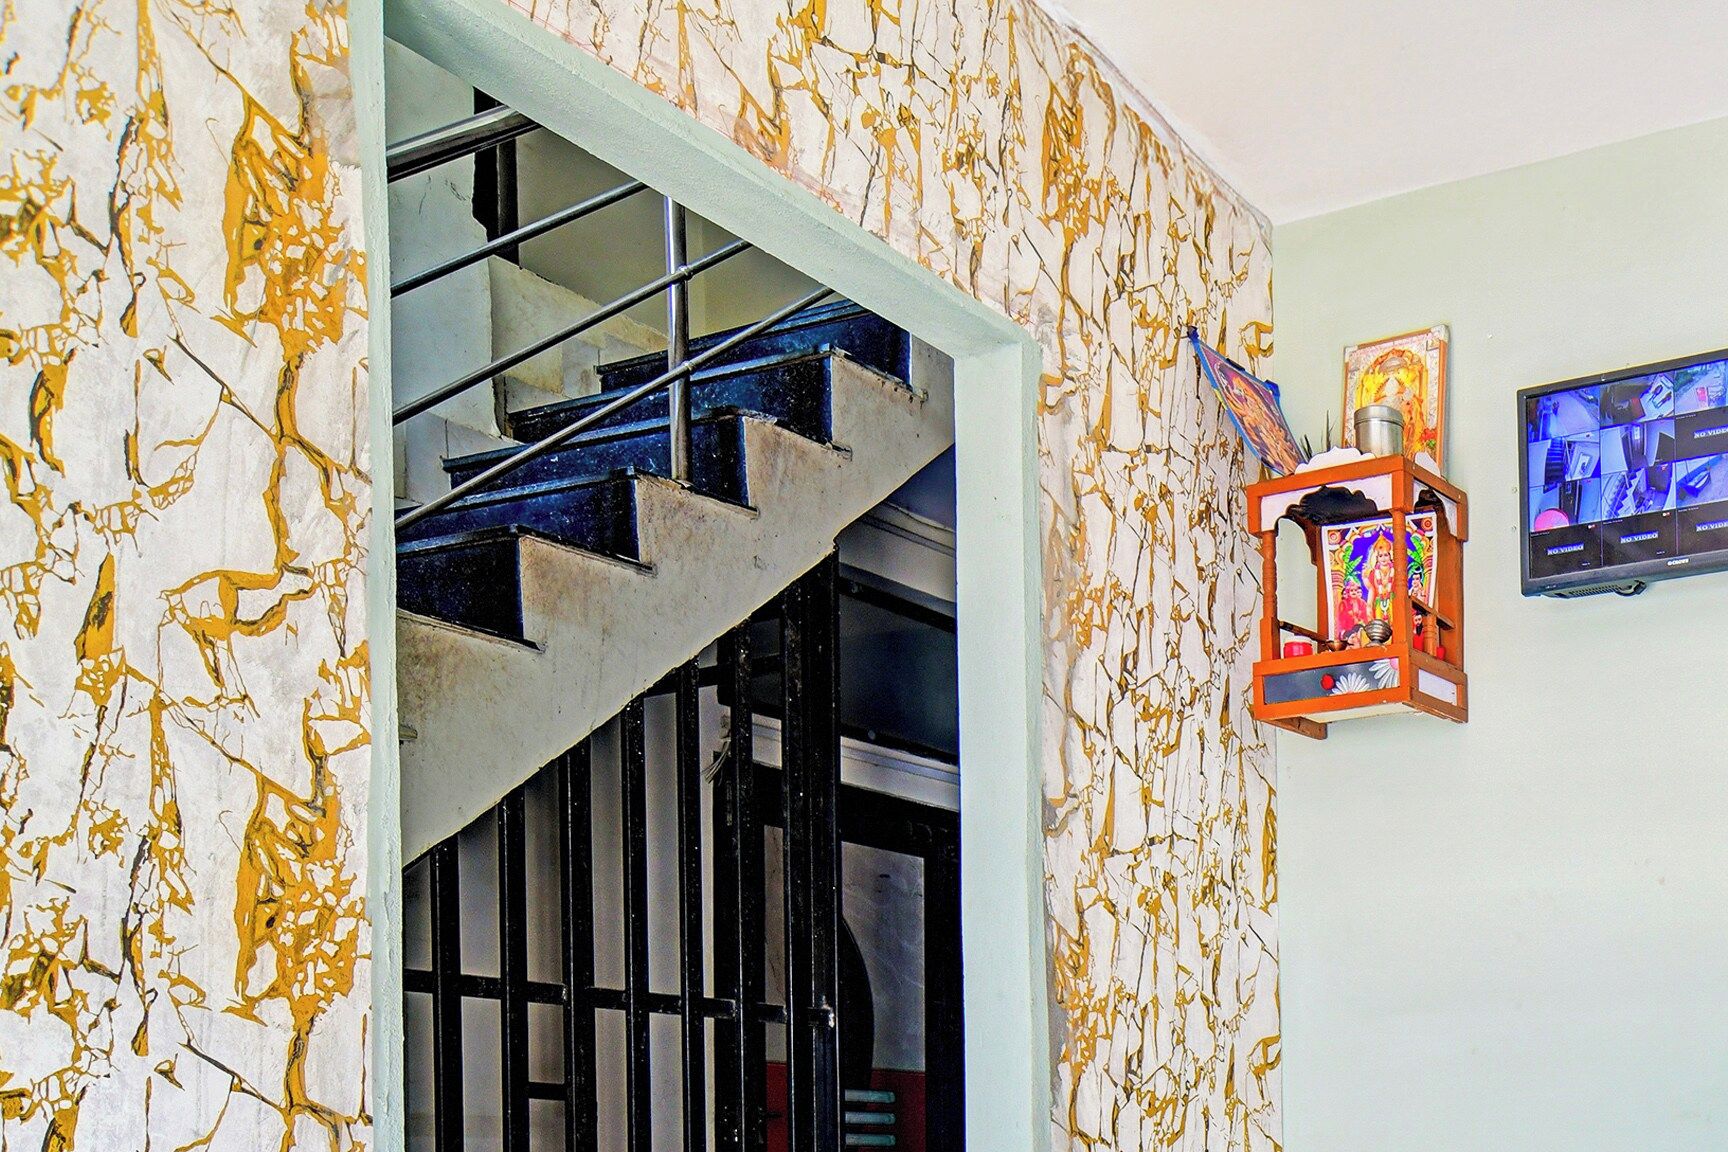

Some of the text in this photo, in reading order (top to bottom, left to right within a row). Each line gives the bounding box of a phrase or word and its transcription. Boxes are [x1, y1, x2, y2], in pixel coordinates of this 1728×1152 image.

[1694, 431, 1706, 439] NO
[1634, 532, 1658, 541] VIDEO
[1561, 543, 1584, 553] VIDEO
